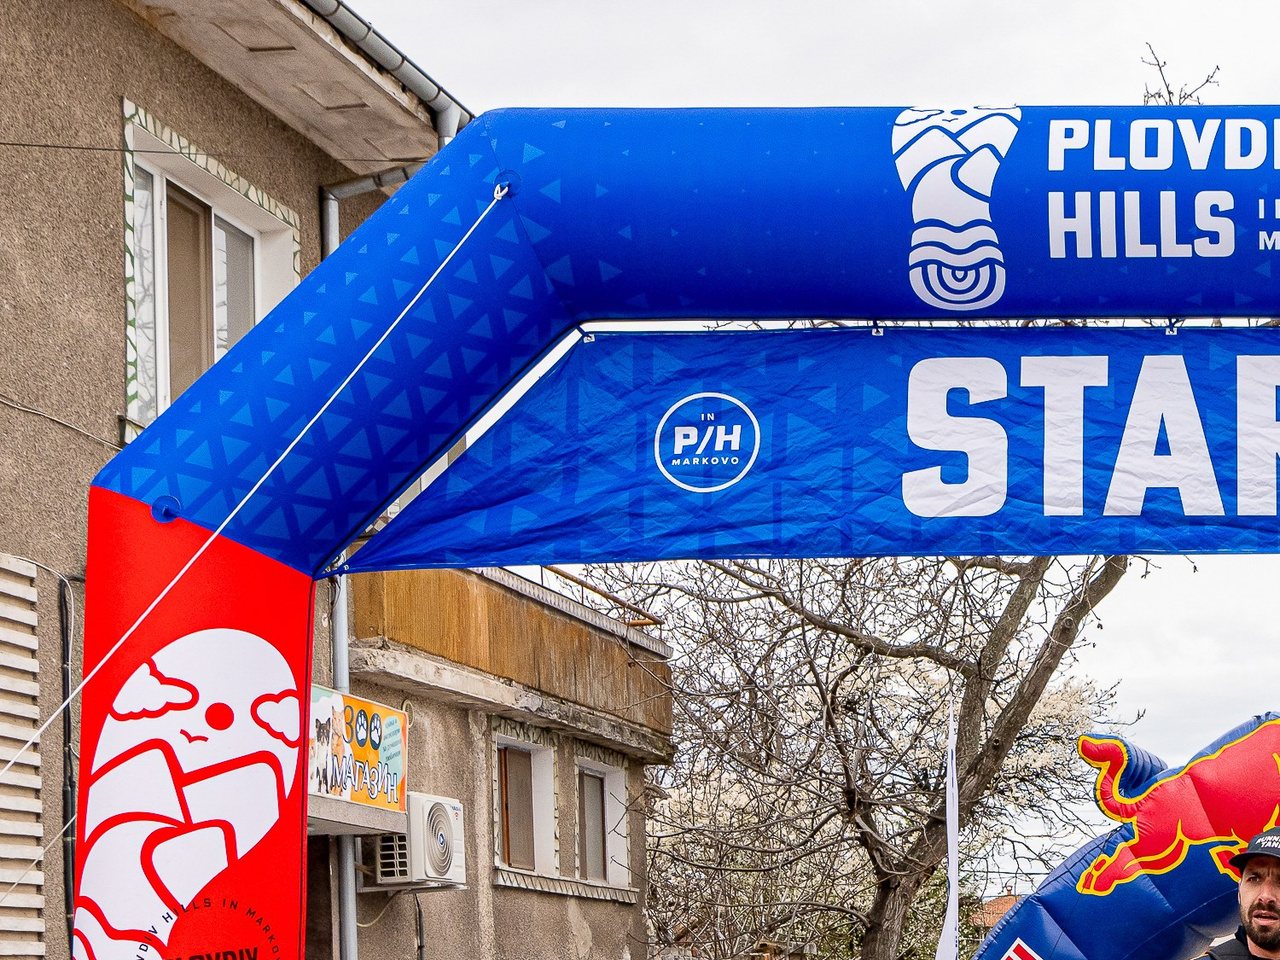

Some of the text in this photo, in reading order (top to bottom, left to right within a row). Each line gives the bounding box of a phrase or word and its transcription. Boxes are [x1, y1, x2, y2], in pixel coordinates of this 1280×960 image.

[1047, 190, 1236, 259] HILLS
[700, 412, 715, 421] IN
[673, 424, 742, 455] P/H
[671, 456, 739, 466] MARKOVO
[332, 754, 399, 804] МАГАЗИН
[161, 897, 212, 923] HILLS
[222, 898, 239, 910] IN
